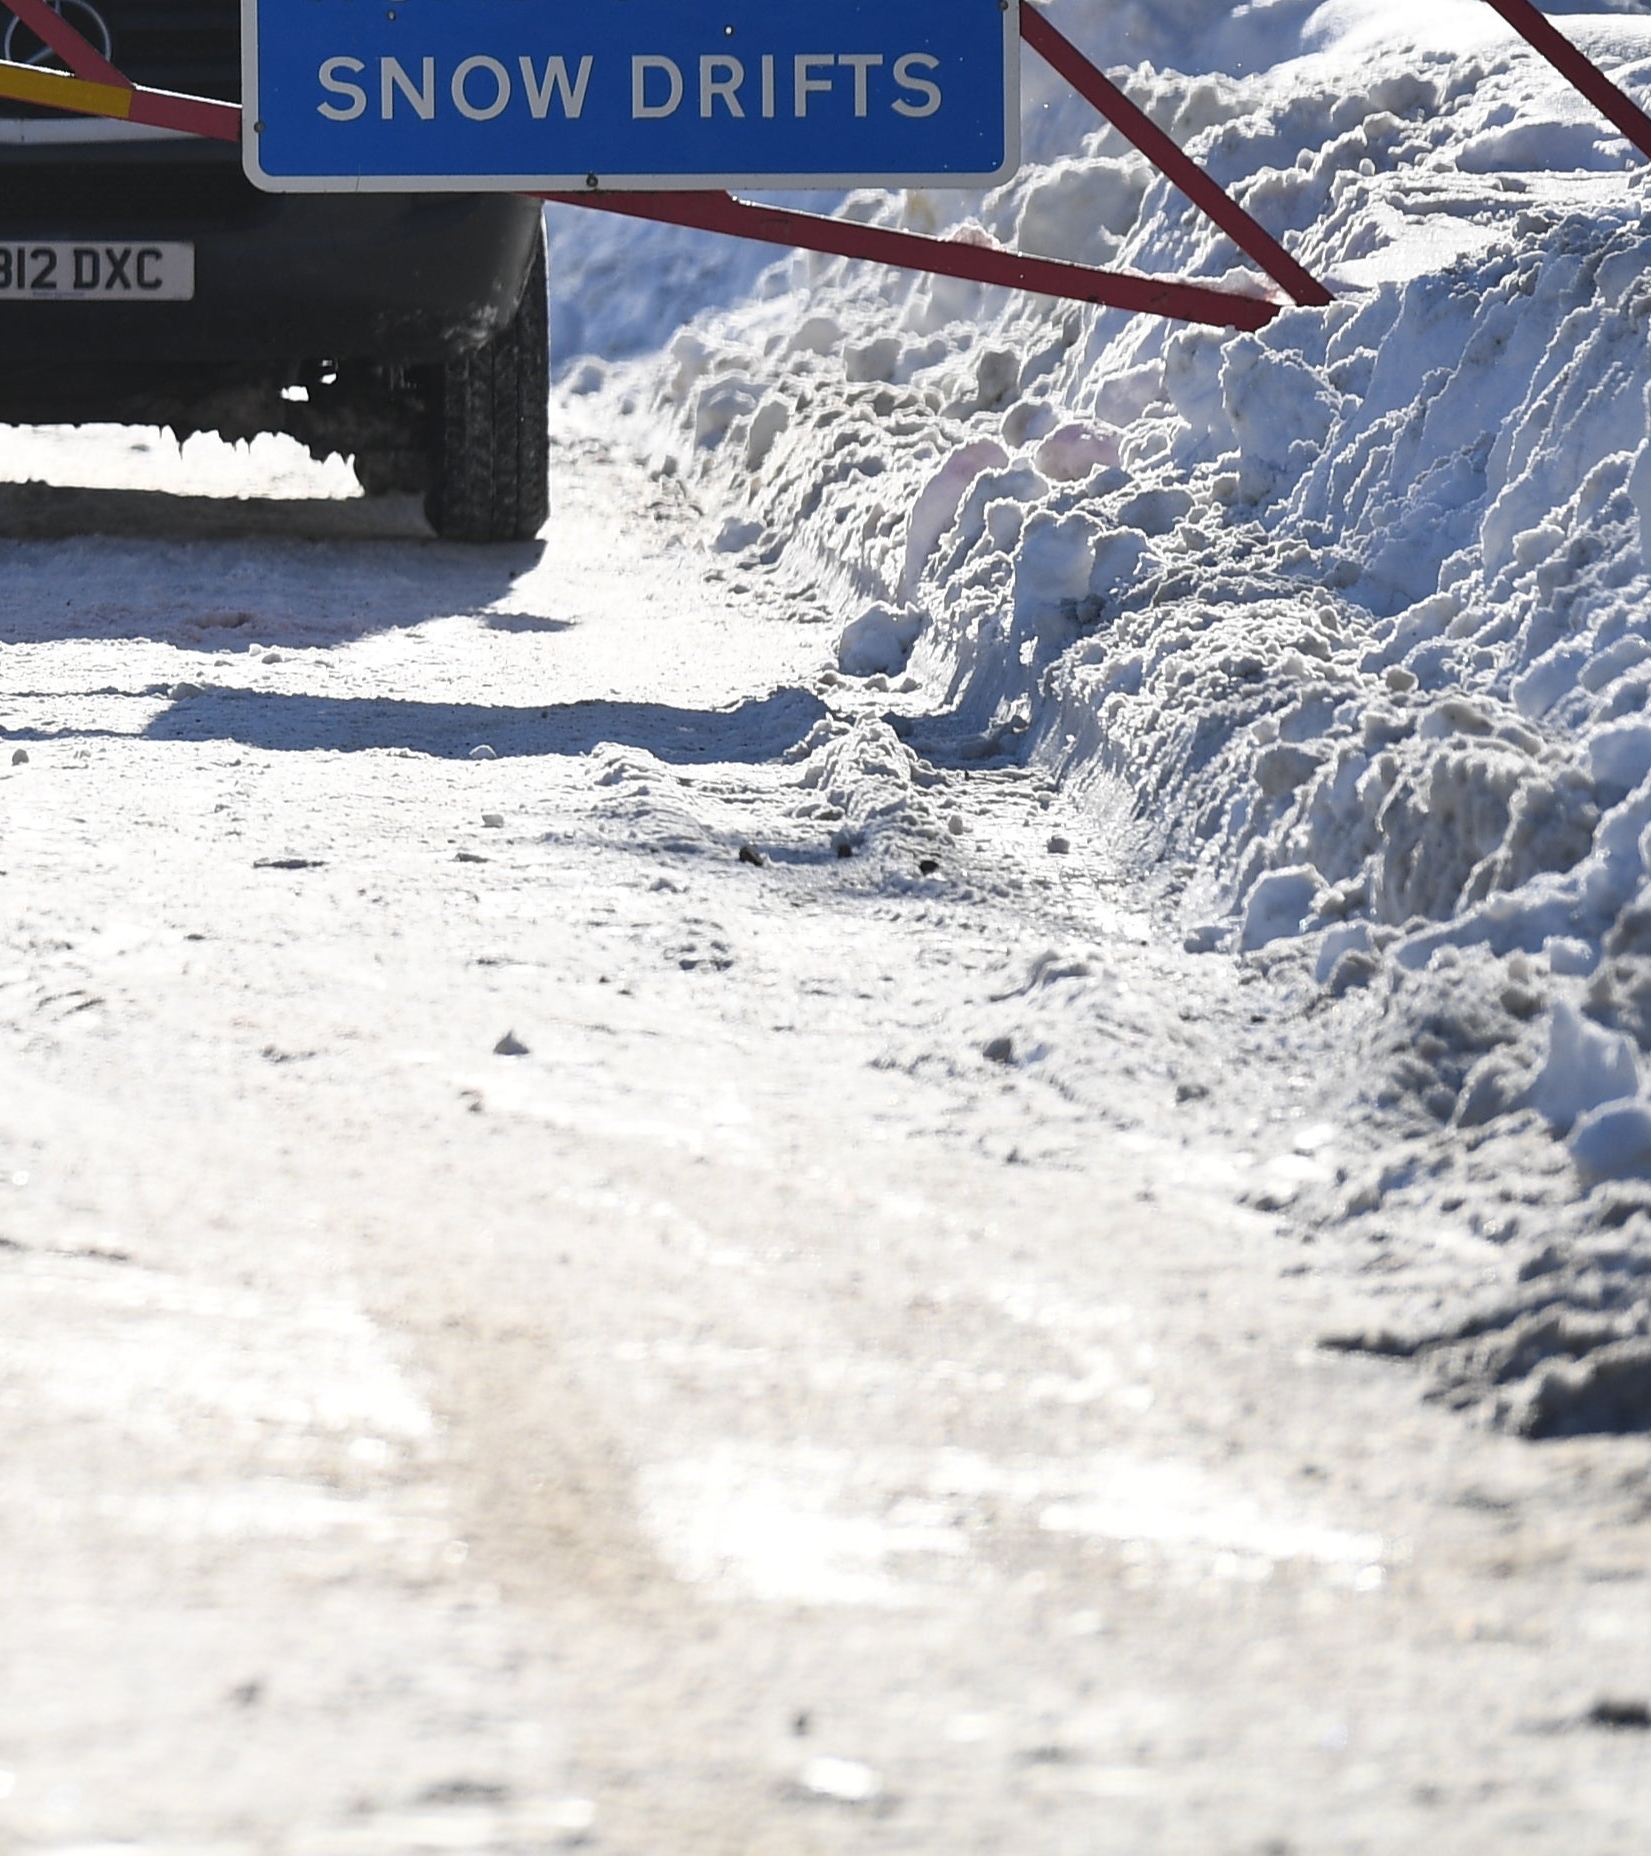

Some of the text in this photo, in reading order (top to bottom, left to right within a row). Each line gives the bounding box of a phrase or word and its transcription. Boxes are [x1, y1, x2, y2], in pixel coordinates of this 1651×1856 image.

[317, 53, 942, 121] SNOW DRIFTS
[73, 247, 163, 290] DXC
